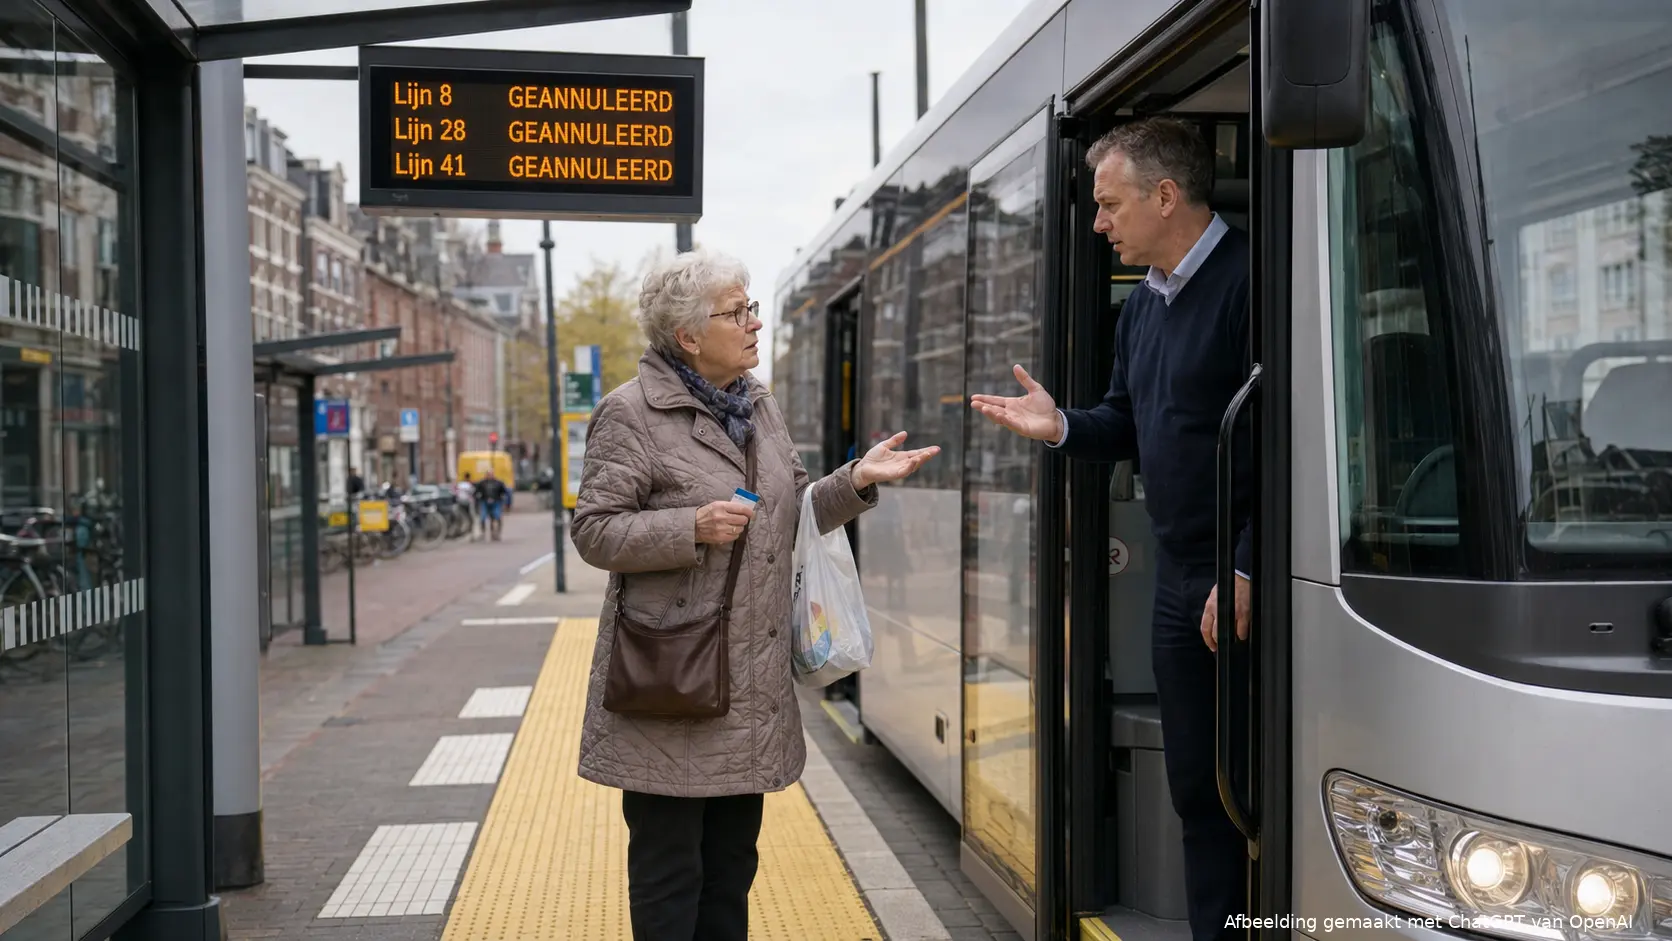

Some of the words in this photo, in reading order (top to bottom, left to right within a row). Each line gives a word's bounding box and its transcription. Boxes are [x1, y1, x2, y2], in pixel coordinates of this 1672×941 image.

[394, 81, 433, 111] Lijn
[439, 83, 453, 107] 8
[508, 86, 673, 112] GEANNULEERD
[395, 117, 433, 146] Lijn
[439, 118, 467, 142] 28
[508, 121, 673, 147] GEANNULEERD
[395, 152, 434, 181] Lijn
[439, 153, 467, 177] 41
[508, 155, 673, 182] GEANNULEERD
